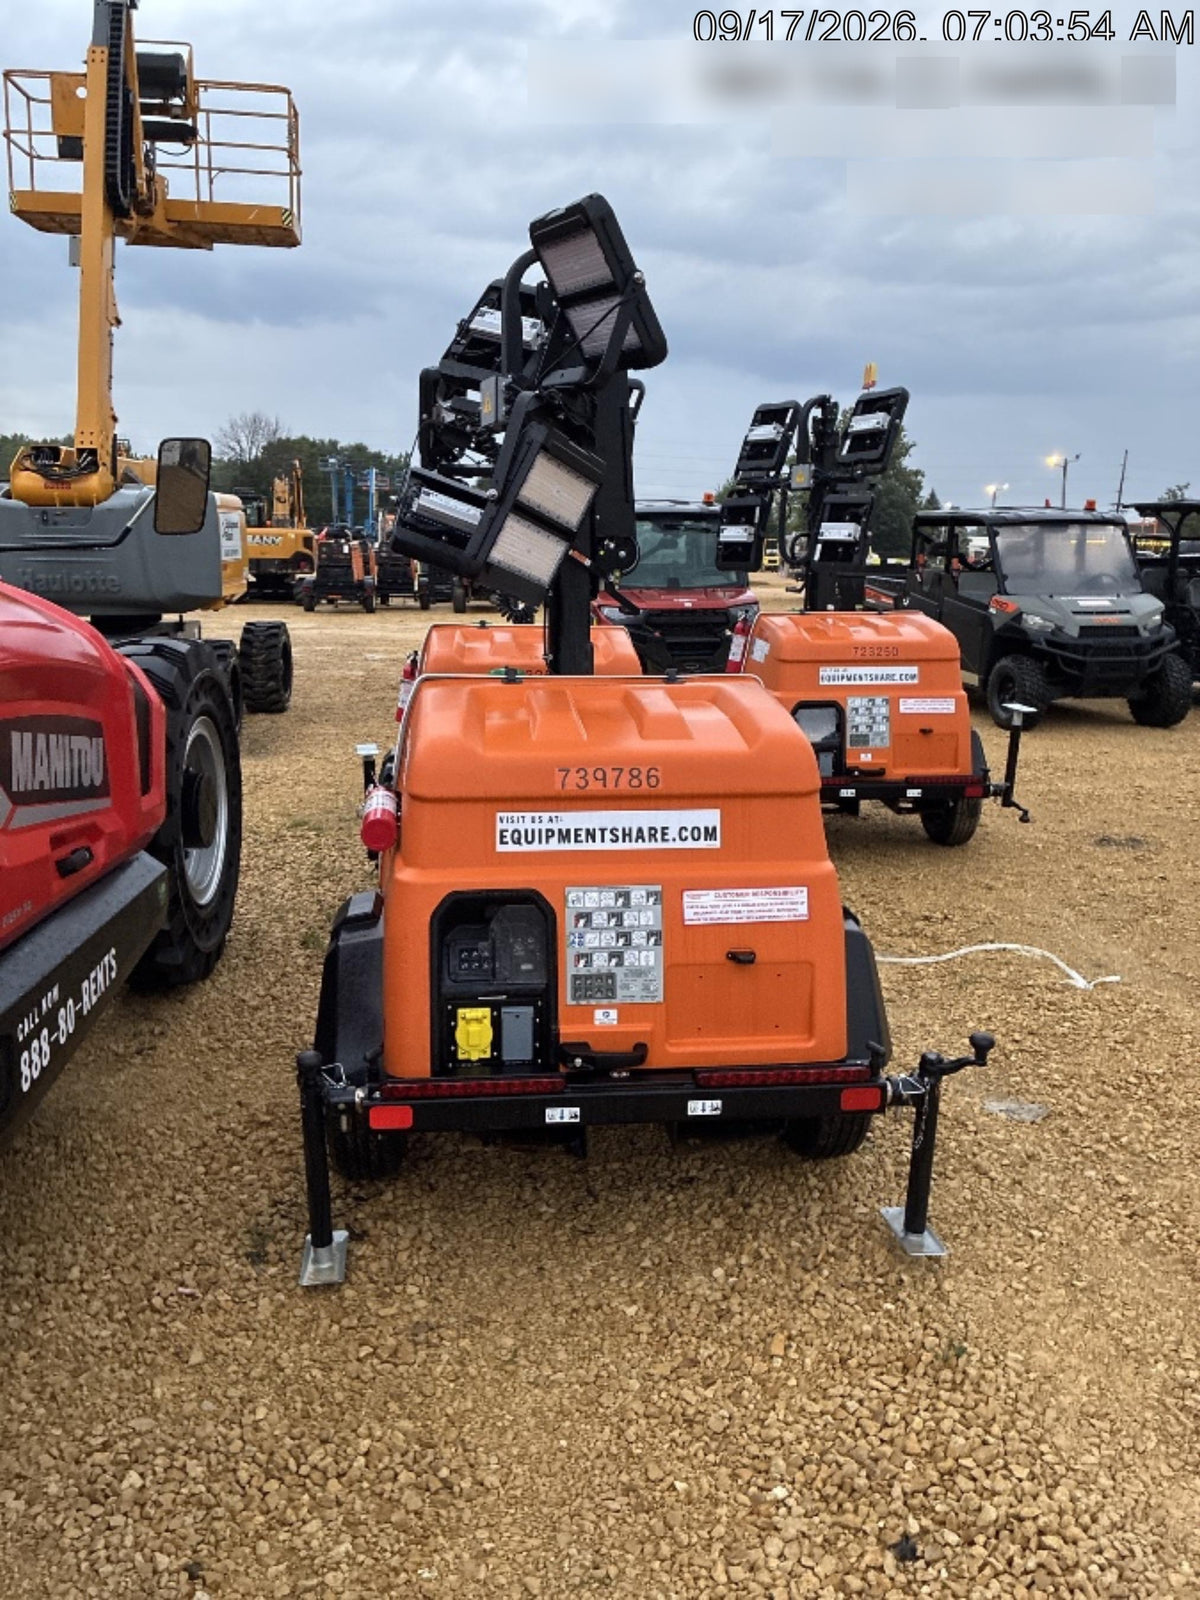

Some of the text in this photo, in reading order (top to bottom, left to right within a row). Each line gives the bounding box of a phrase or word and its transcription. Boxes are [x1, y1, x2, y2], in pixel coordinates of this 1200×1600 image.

[10, 730, 104, 792] MANITOU
[557, 767, 661, 790] 739786
[498, 825, 719, 847] EQUIPMENTSHARE.COM
[499, 815, 526, 824] VISIT
[531, 815, 543, 824] US
[17, 982, 60, 1043] CALL NOW
[20, 946, 118, 1093] 888-80-RENTS
